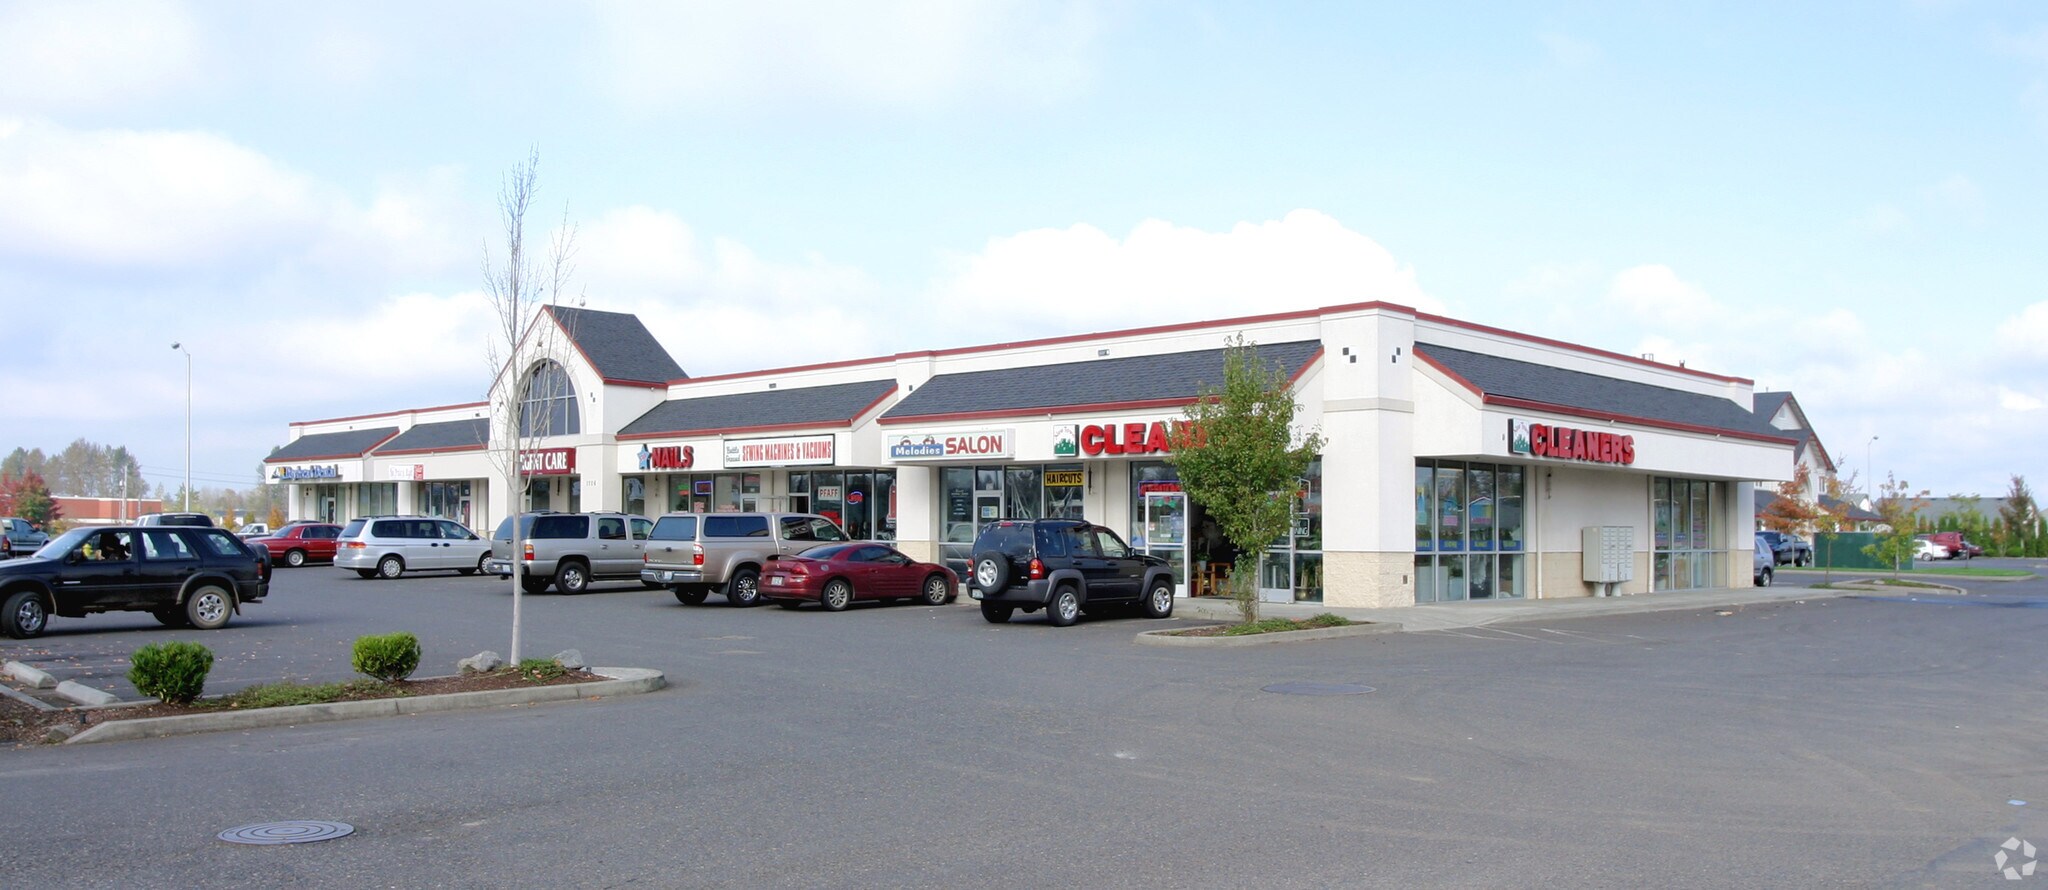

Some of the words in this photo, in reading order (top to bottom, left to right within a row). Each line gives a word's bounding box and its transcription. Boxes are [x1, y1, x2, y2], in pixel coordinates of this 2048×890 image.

[742, 444, 763, 462] SEWING
[764, 442, 794, 461] MACHINES
[796, 443, 801, 459] &
[802, 441, 832, 459] VACUUMS
[895, 446, 940, 456] Melodies
[945, 435, 1003, 454] SALON
[1531, 424, 1635, 465] CLEANERS
[519, 453, 545, 471] RGENT
[545, 451, 568, 470] CARE
[652, 445, 694, 468] NAILS
[1046, 473, 1082, 484] HAIRCUTS
[820, 488, 838, 497] PFAFF
